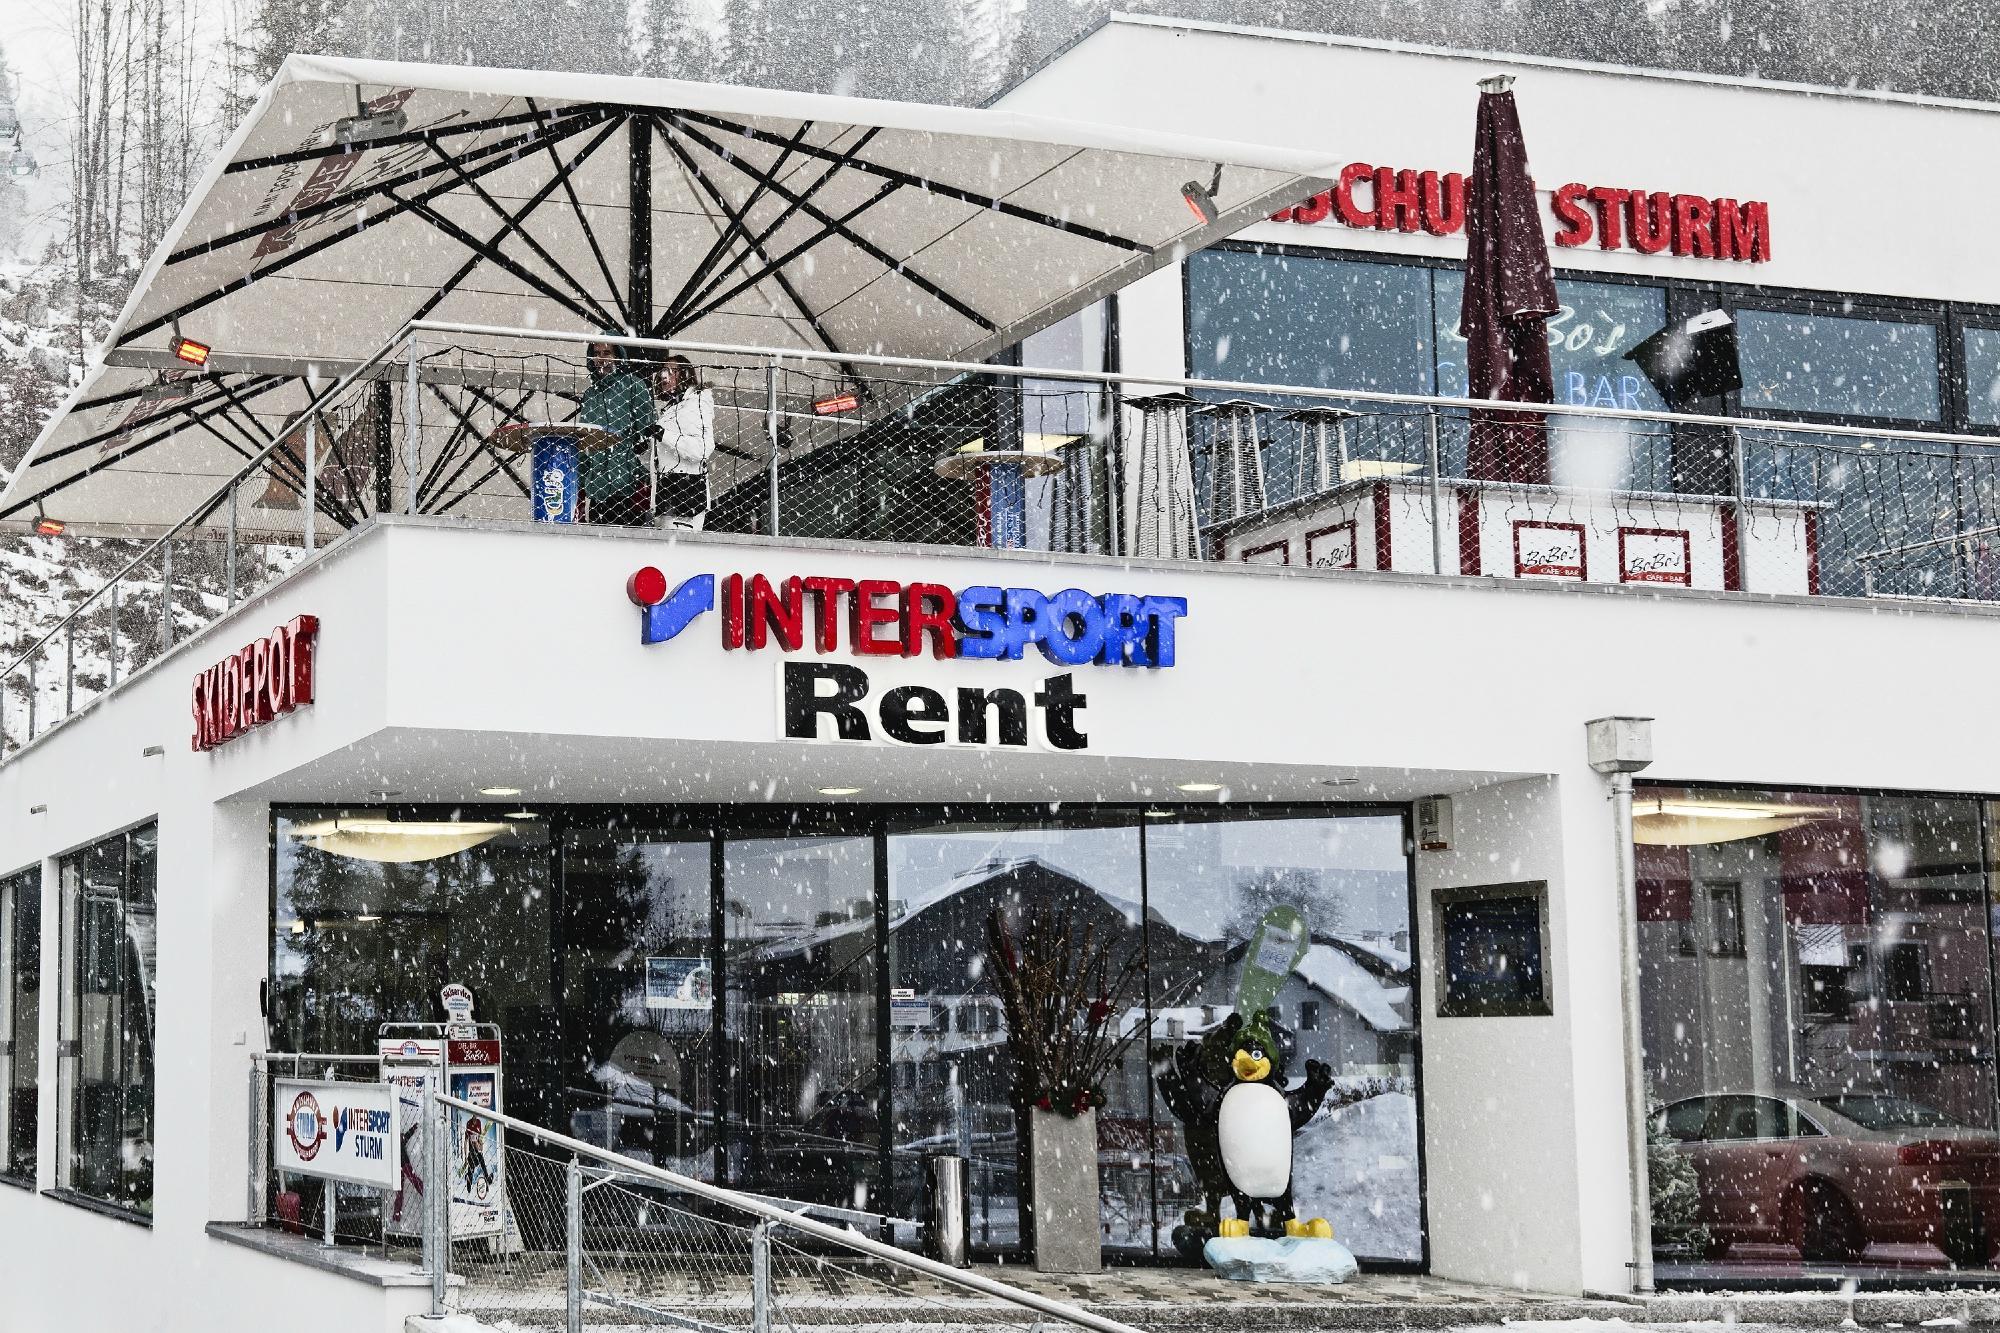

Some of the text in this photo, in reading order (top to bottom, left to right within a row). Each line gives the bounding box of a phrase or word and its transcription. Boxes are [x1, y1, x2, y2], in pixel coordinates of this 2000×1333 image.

[1553, 182, 1771, 264] STURM
[1568, 372, 1642, 411] BAR
[721, 572, 1188, 668] INTERSPORT
[191, 614, 319, 752] SKIDEPOT
[781, 661, 1089, 750] Rent
[348, 1107, 391, 1134] INTERSPORT
[355, 1134, 383, 1160] STURM
